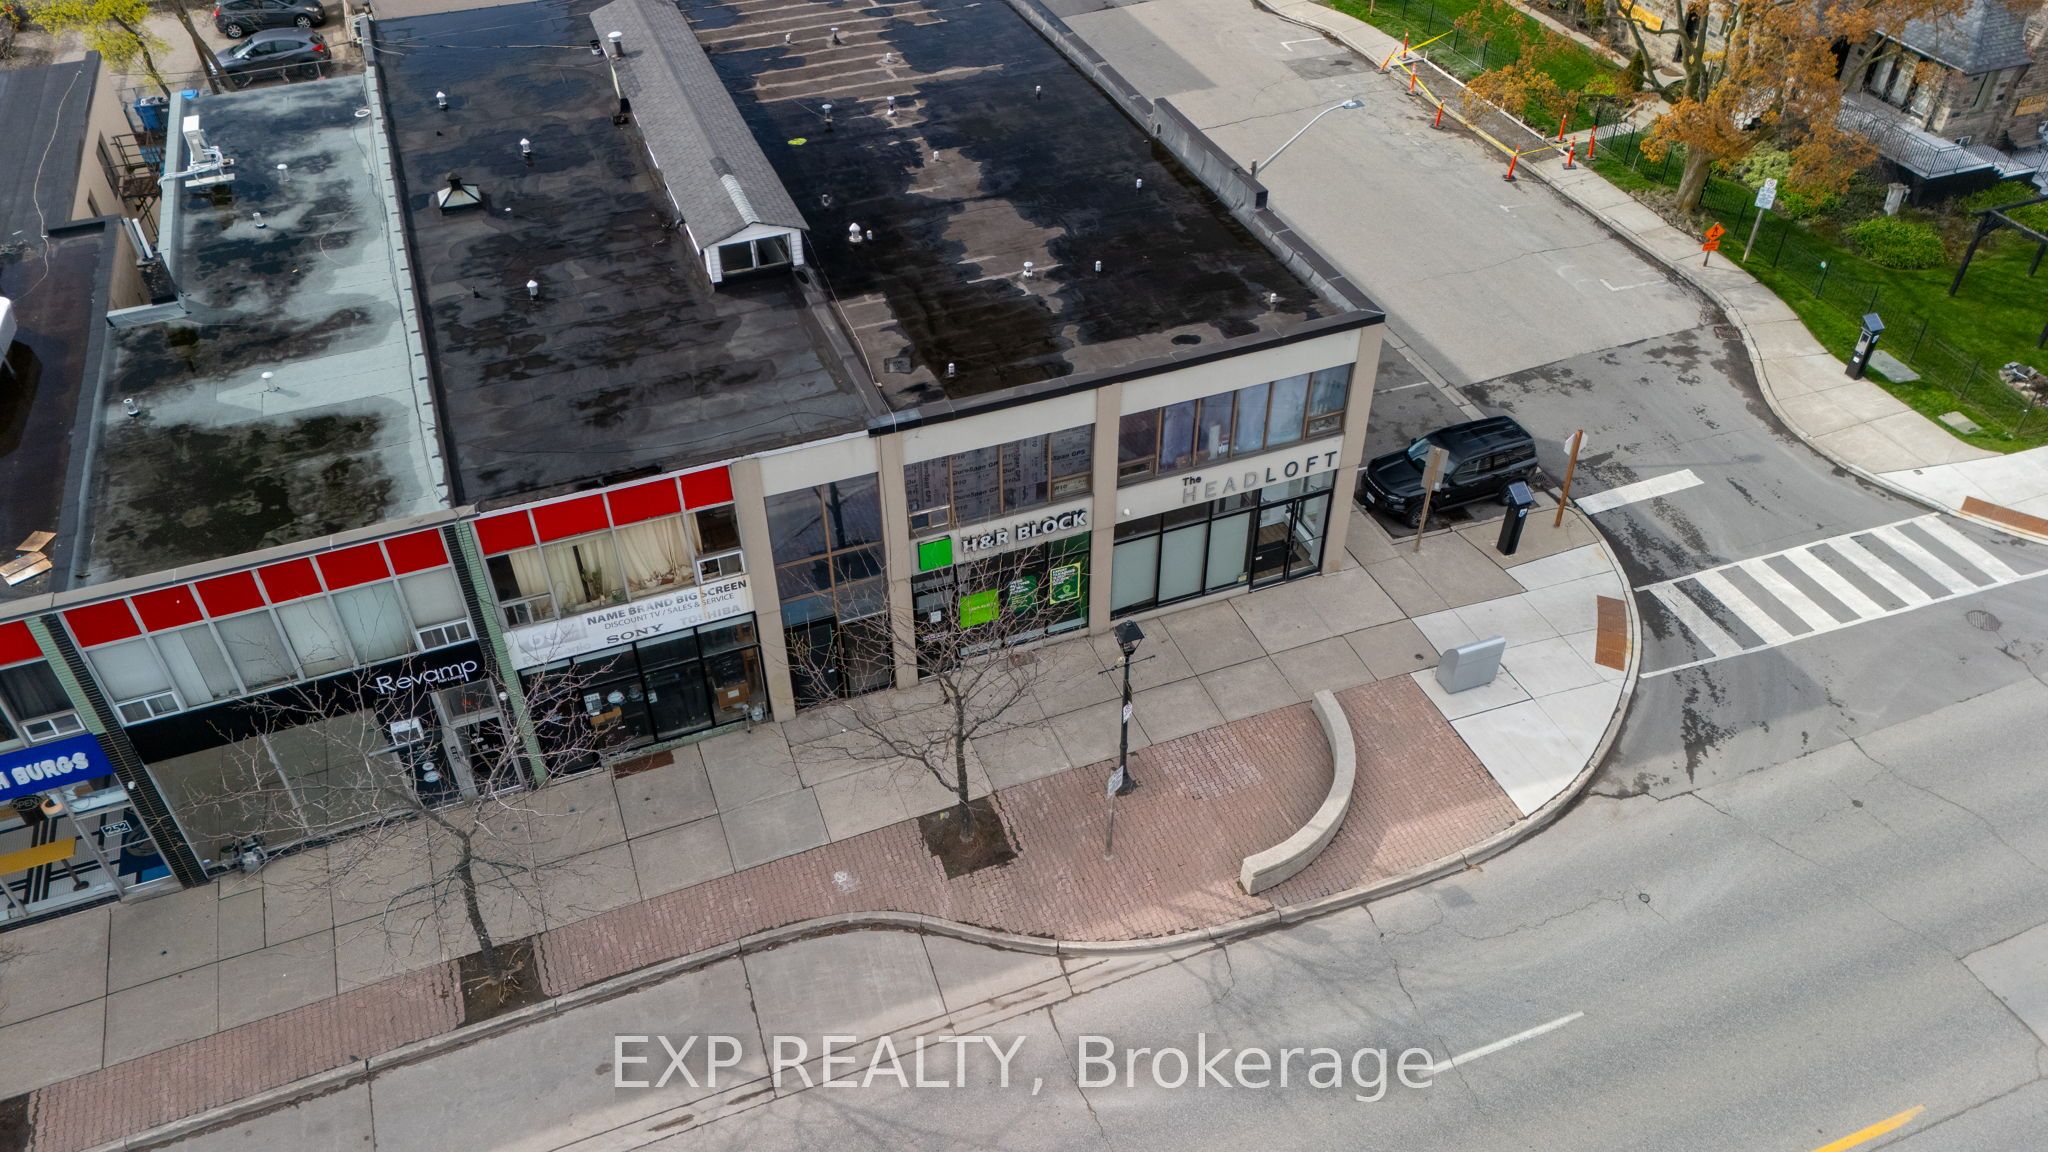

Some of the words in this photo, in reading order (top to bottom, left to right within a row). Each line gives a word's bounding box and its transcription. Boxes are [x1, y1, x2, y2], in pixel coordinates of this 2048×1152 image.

[1182, 476, 1202, 486] The
[962, 529, 1009, 553] H&R
[1017, 509, 1087, 541] BLOCK
[587, 609, 626, 626] NAME
[628, 598, 674, 615] BRAND
[676, 592, 698, 604] BIG
[701, 579, 748, 598] SCREEN
[604, 614, 649, 630] DISCOUNT
[650, 610, 662, 619] TV
[667, 603, 693, 615] SALES
[701, 592, 736, 606] SERVICE
[606, 623, 665, 645] SONY
[375, 660, 478, 694] Revamp
[11, 752, 89, 785] BURGS
[105, 822, 129, 835] 252
